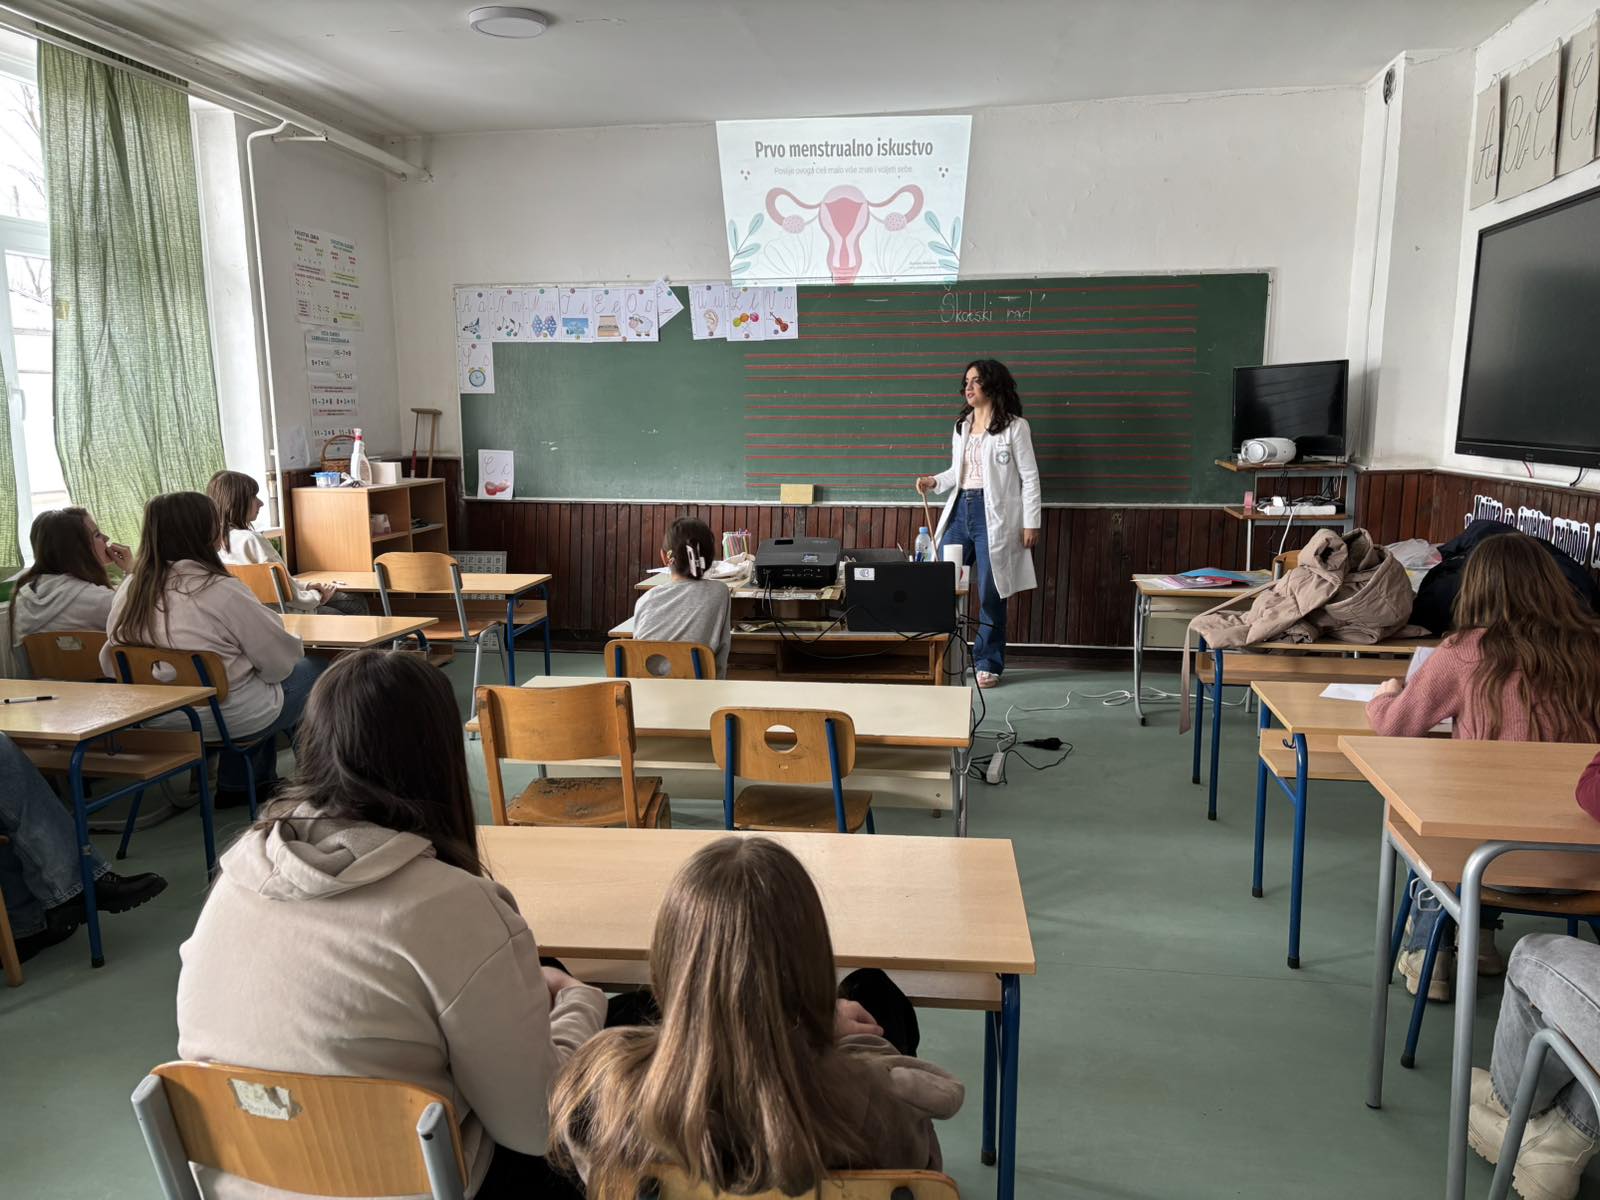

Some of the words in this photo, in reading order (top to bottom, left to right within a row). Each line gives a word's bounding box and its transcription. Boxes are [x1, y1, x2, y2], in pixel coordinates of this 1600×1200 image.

[755, 140, 785, 158] Prvo
[789, 138, 873, 158] menstrualno
[877, 137, 933, 157] iskustvo
[828, 165, 844, 174] malo
